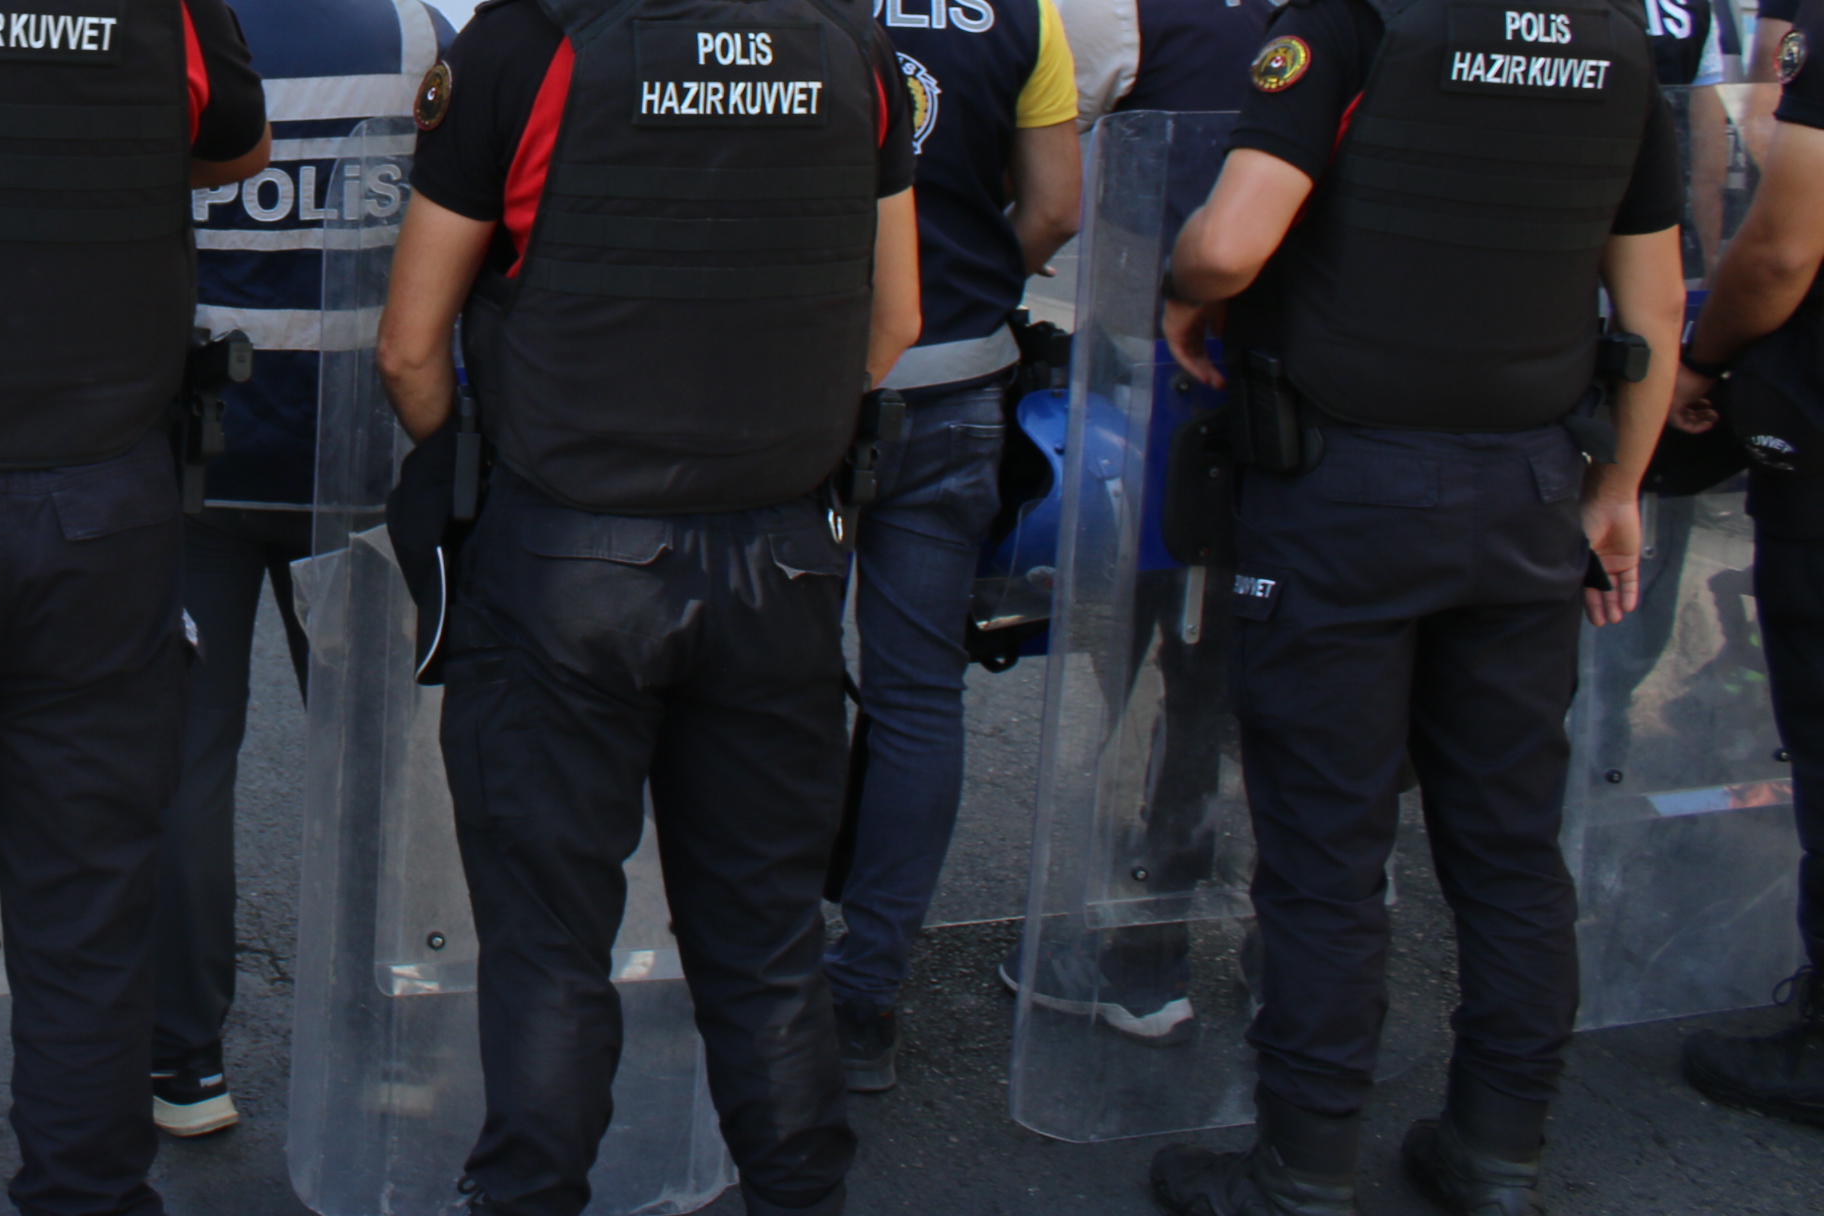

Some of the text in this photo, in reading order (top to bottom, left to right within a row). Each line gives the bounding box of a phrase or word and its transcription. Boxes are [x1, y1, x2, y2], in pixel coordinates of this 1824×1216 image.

[9, 13, 117, 51] KUVVET
[1451, 51, 1611, 89] HAZIR KUVVET
[641, 81, 822, 115] HAZIR KUVVET
